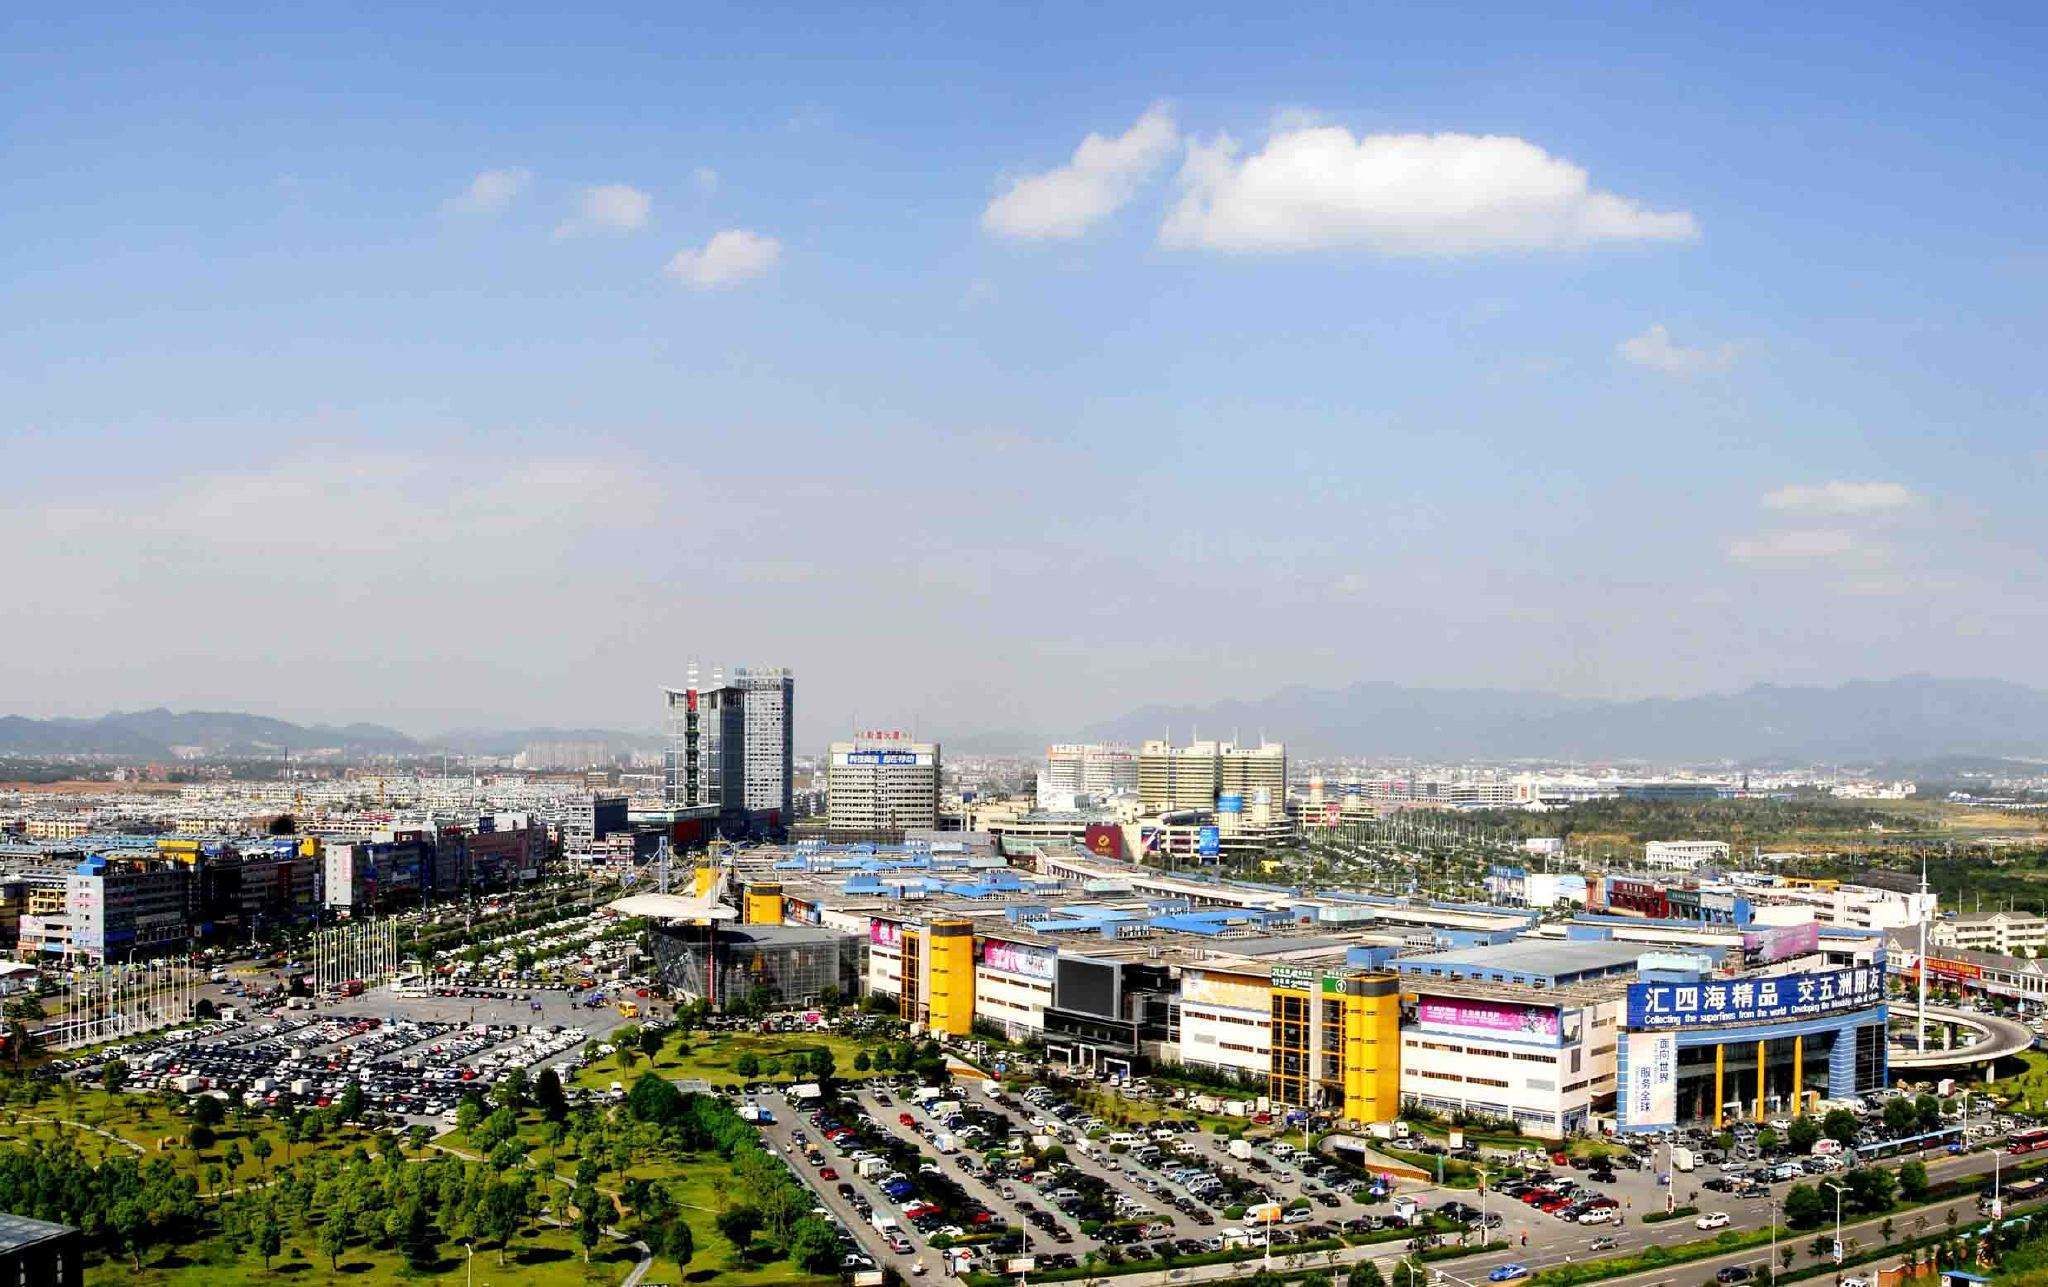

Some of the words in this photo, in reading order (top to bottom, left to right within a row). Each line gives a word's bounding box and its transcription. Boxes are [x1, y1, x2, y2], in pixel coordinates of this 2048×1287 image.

[1645, 982, 1778, 1013] 汇四海精品
[1798, 967, 1879, 1003] 交五洲朋友
[1644, 1015, 1681, 1026] Collecting
[1685, 1013, 1697, 1022] the
[1700, 1011, 1736, 1023] superfines
[1739, 1010, 1754, 1019] from
[1757, 1008, 1768, 1018] the
[1770, 1006, 1786, 1016] world
[1791, 1003, 1820, 1015] Developing
[1659, 1038, 1670, 1084] 面向世界
[1640, 1066, 1651, 1112] 服务全球
